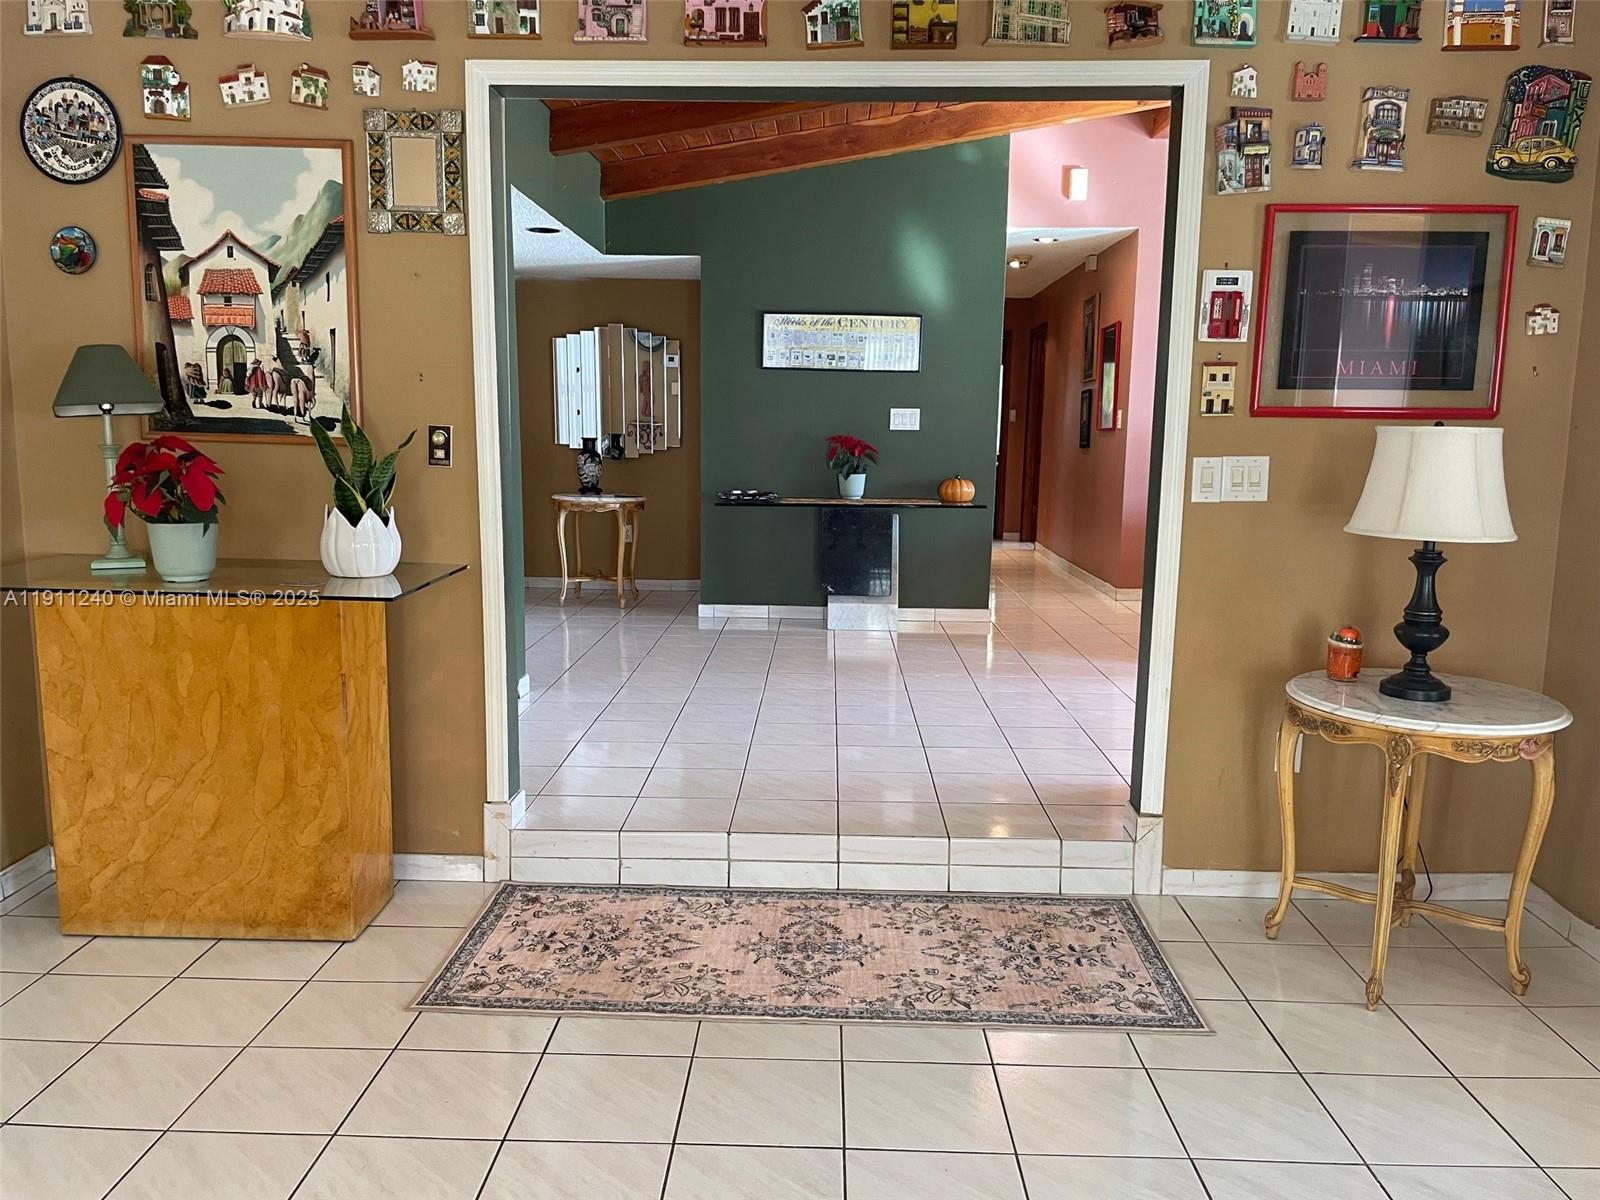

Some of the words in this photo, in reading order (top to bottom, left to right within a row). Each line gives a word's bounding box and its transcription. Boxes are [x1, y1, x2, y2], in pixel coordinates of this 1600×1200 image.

[821, 318, 834, 327] the
[836, 316, 909, 329] CENTURY
[1338, 360, 1418, 376] MIAMI
